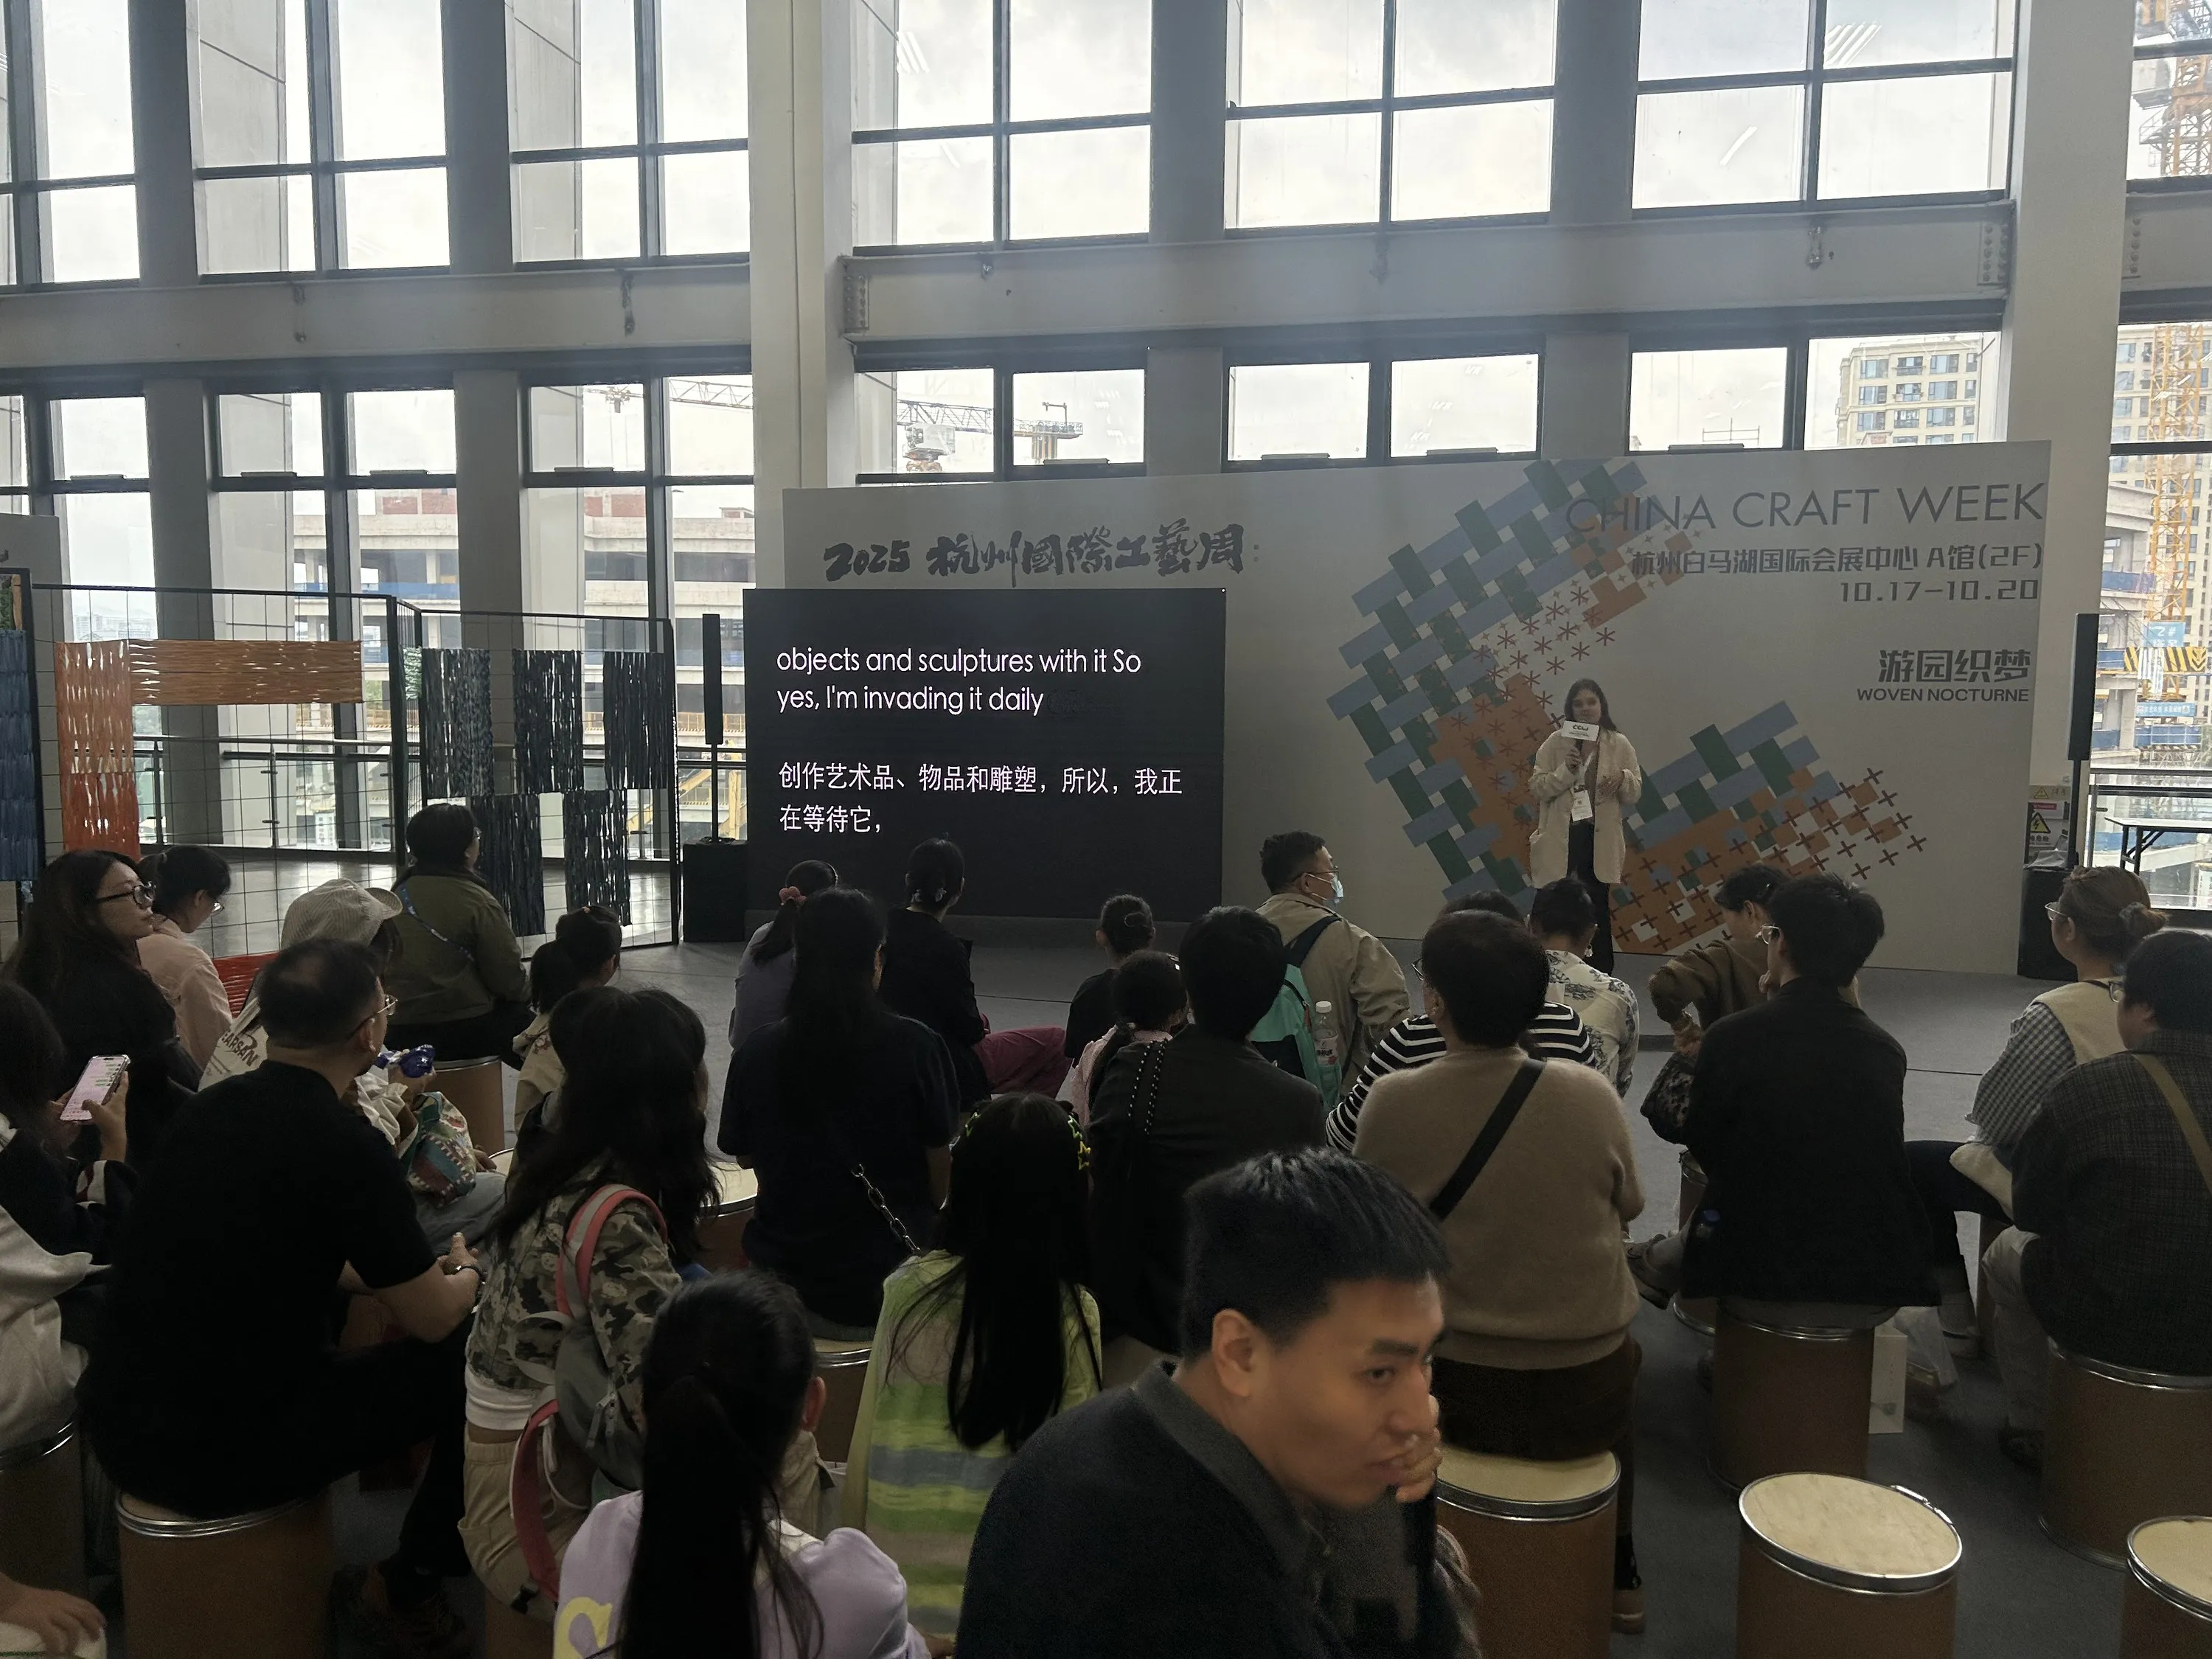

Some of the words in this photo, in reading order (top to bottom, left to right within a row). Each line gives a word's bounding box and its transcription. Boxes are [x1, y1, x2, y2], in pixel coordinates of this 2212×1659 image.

[1565, 493, 1717, 532] CHINA
[1733, 488, 1879, 529] CRAFT
[1896, 482, 2045, 524] WEEK
[823, 540, 911, 582] 2025
[1631, 546, 1919, 576] 杭州白马湖国际会展中心
[1926, 543, 2043, 571] A馆(2F)
[1840, 579, 2039, 603] 10.17-10.20
[776, 647, 860, 675] objects
[866, 647, 911, 672] and
[918, 647, 1034, 678] sculptures
[1038, 648, 1087, 673] with
[1093, 648, 1107, 673] it
[1113, 648, 1141, 673] So
[1878, 648, 2031, 684] 游园织梦
[776, 689, 820, 714] yes,
[827, 684, 858, 709] I'm
[863, 685, 964, 716] invading
[970, 686, 983, 711] it
[988, 686, 1044, 717] daily
[1857, 688, 1923, 701] WOVEN
[1927, 688, 2030, 702] NOCTURNE
[779, 761, 1183, 796] 创作艺术品、物品和雕塑，所以，我正
[779, 804, 881, 833] 在等待它，
